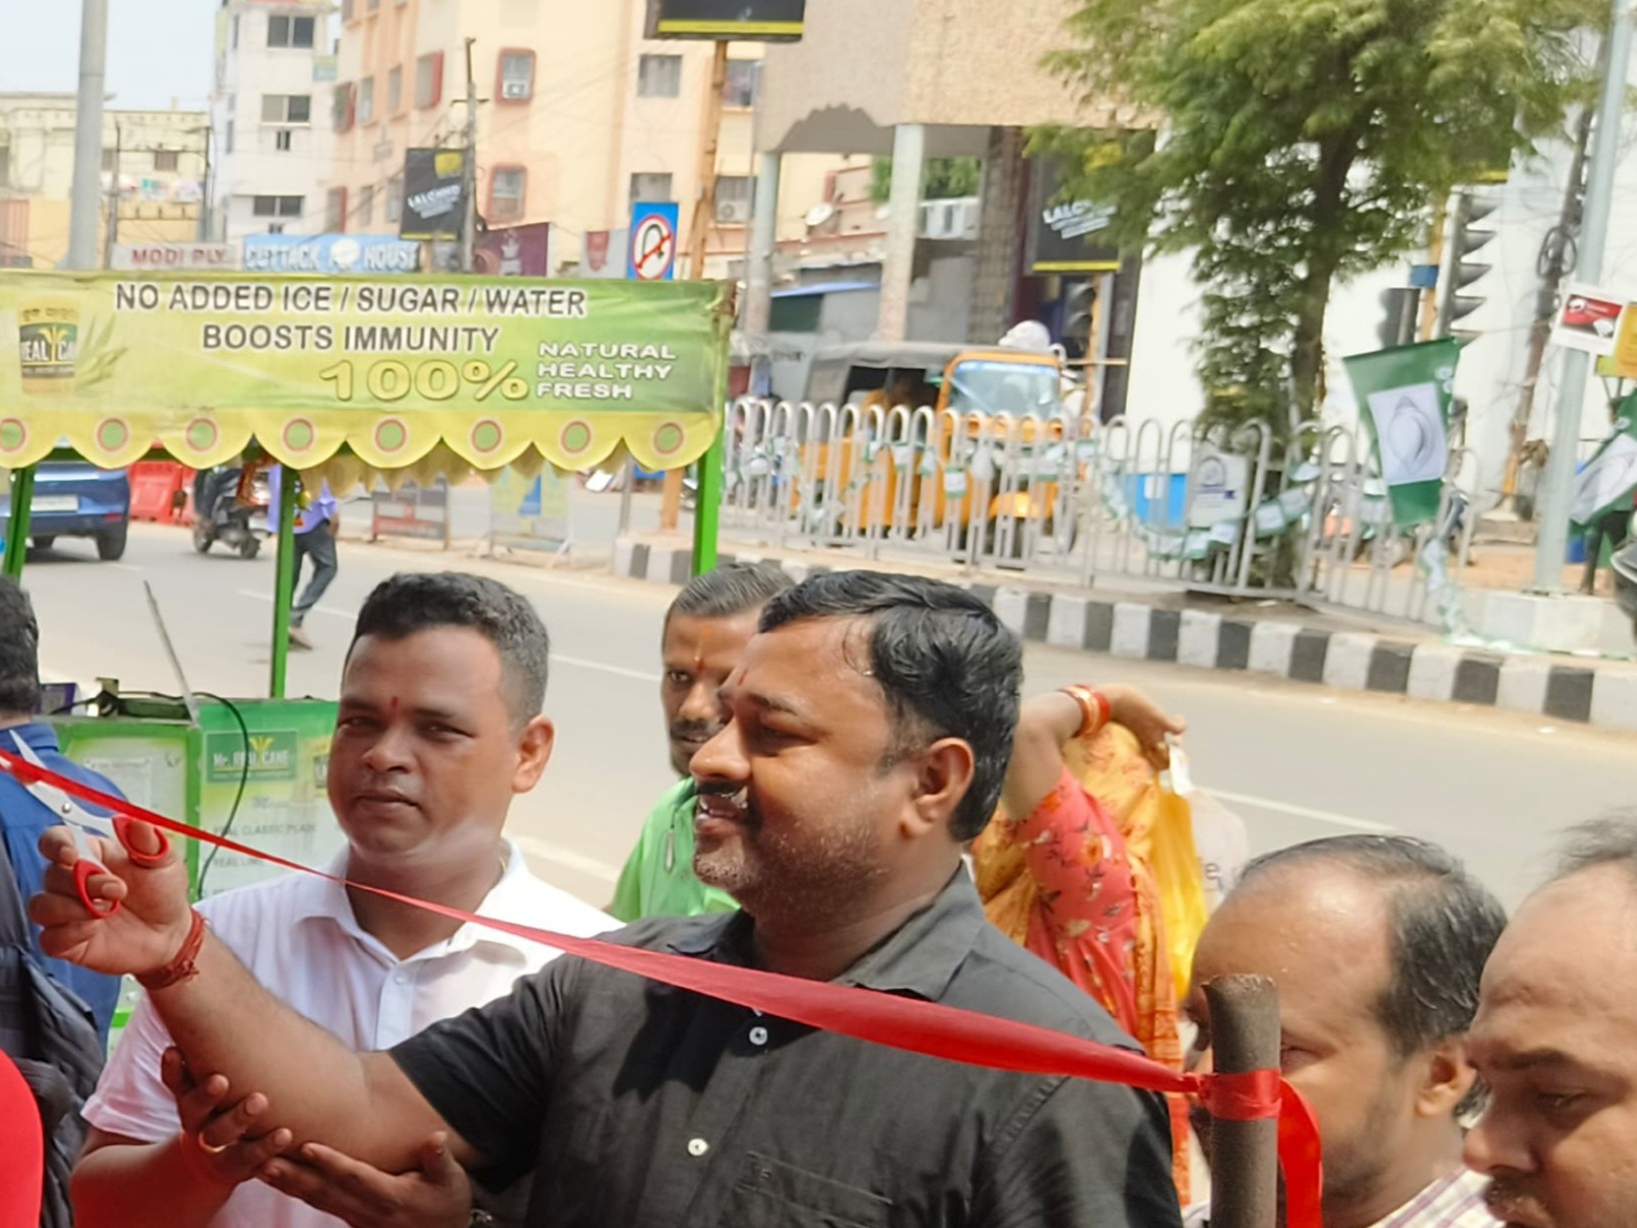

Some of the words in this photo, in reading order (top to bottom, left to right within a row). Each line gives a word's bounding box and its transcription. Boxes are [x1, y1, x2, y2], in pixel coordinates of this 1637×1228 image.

[131, 249, 184, 265] MODI
[192, 249, 227, 265] PLY
[117, 284, 159, 310] NO
[169, 285, 273, 311] ADDED
[283, 286, 332, 311] ICE
[340, 286, 349, 312] /
[357, 287, 459, 313] SUGAR
[468, 289, 477, 313] /
[486, 288, 585, 315] WATER
[203, 324, 333, 350] BOOSTS
[345, 326, 499, 351] IMMUNITY
[538, 342, 677, 360] NATURAL
[320, 359, 529, 401] 100%
[538, 363, 673, 380] HEALTHY
[537, 382, 633, 400] FRESH
